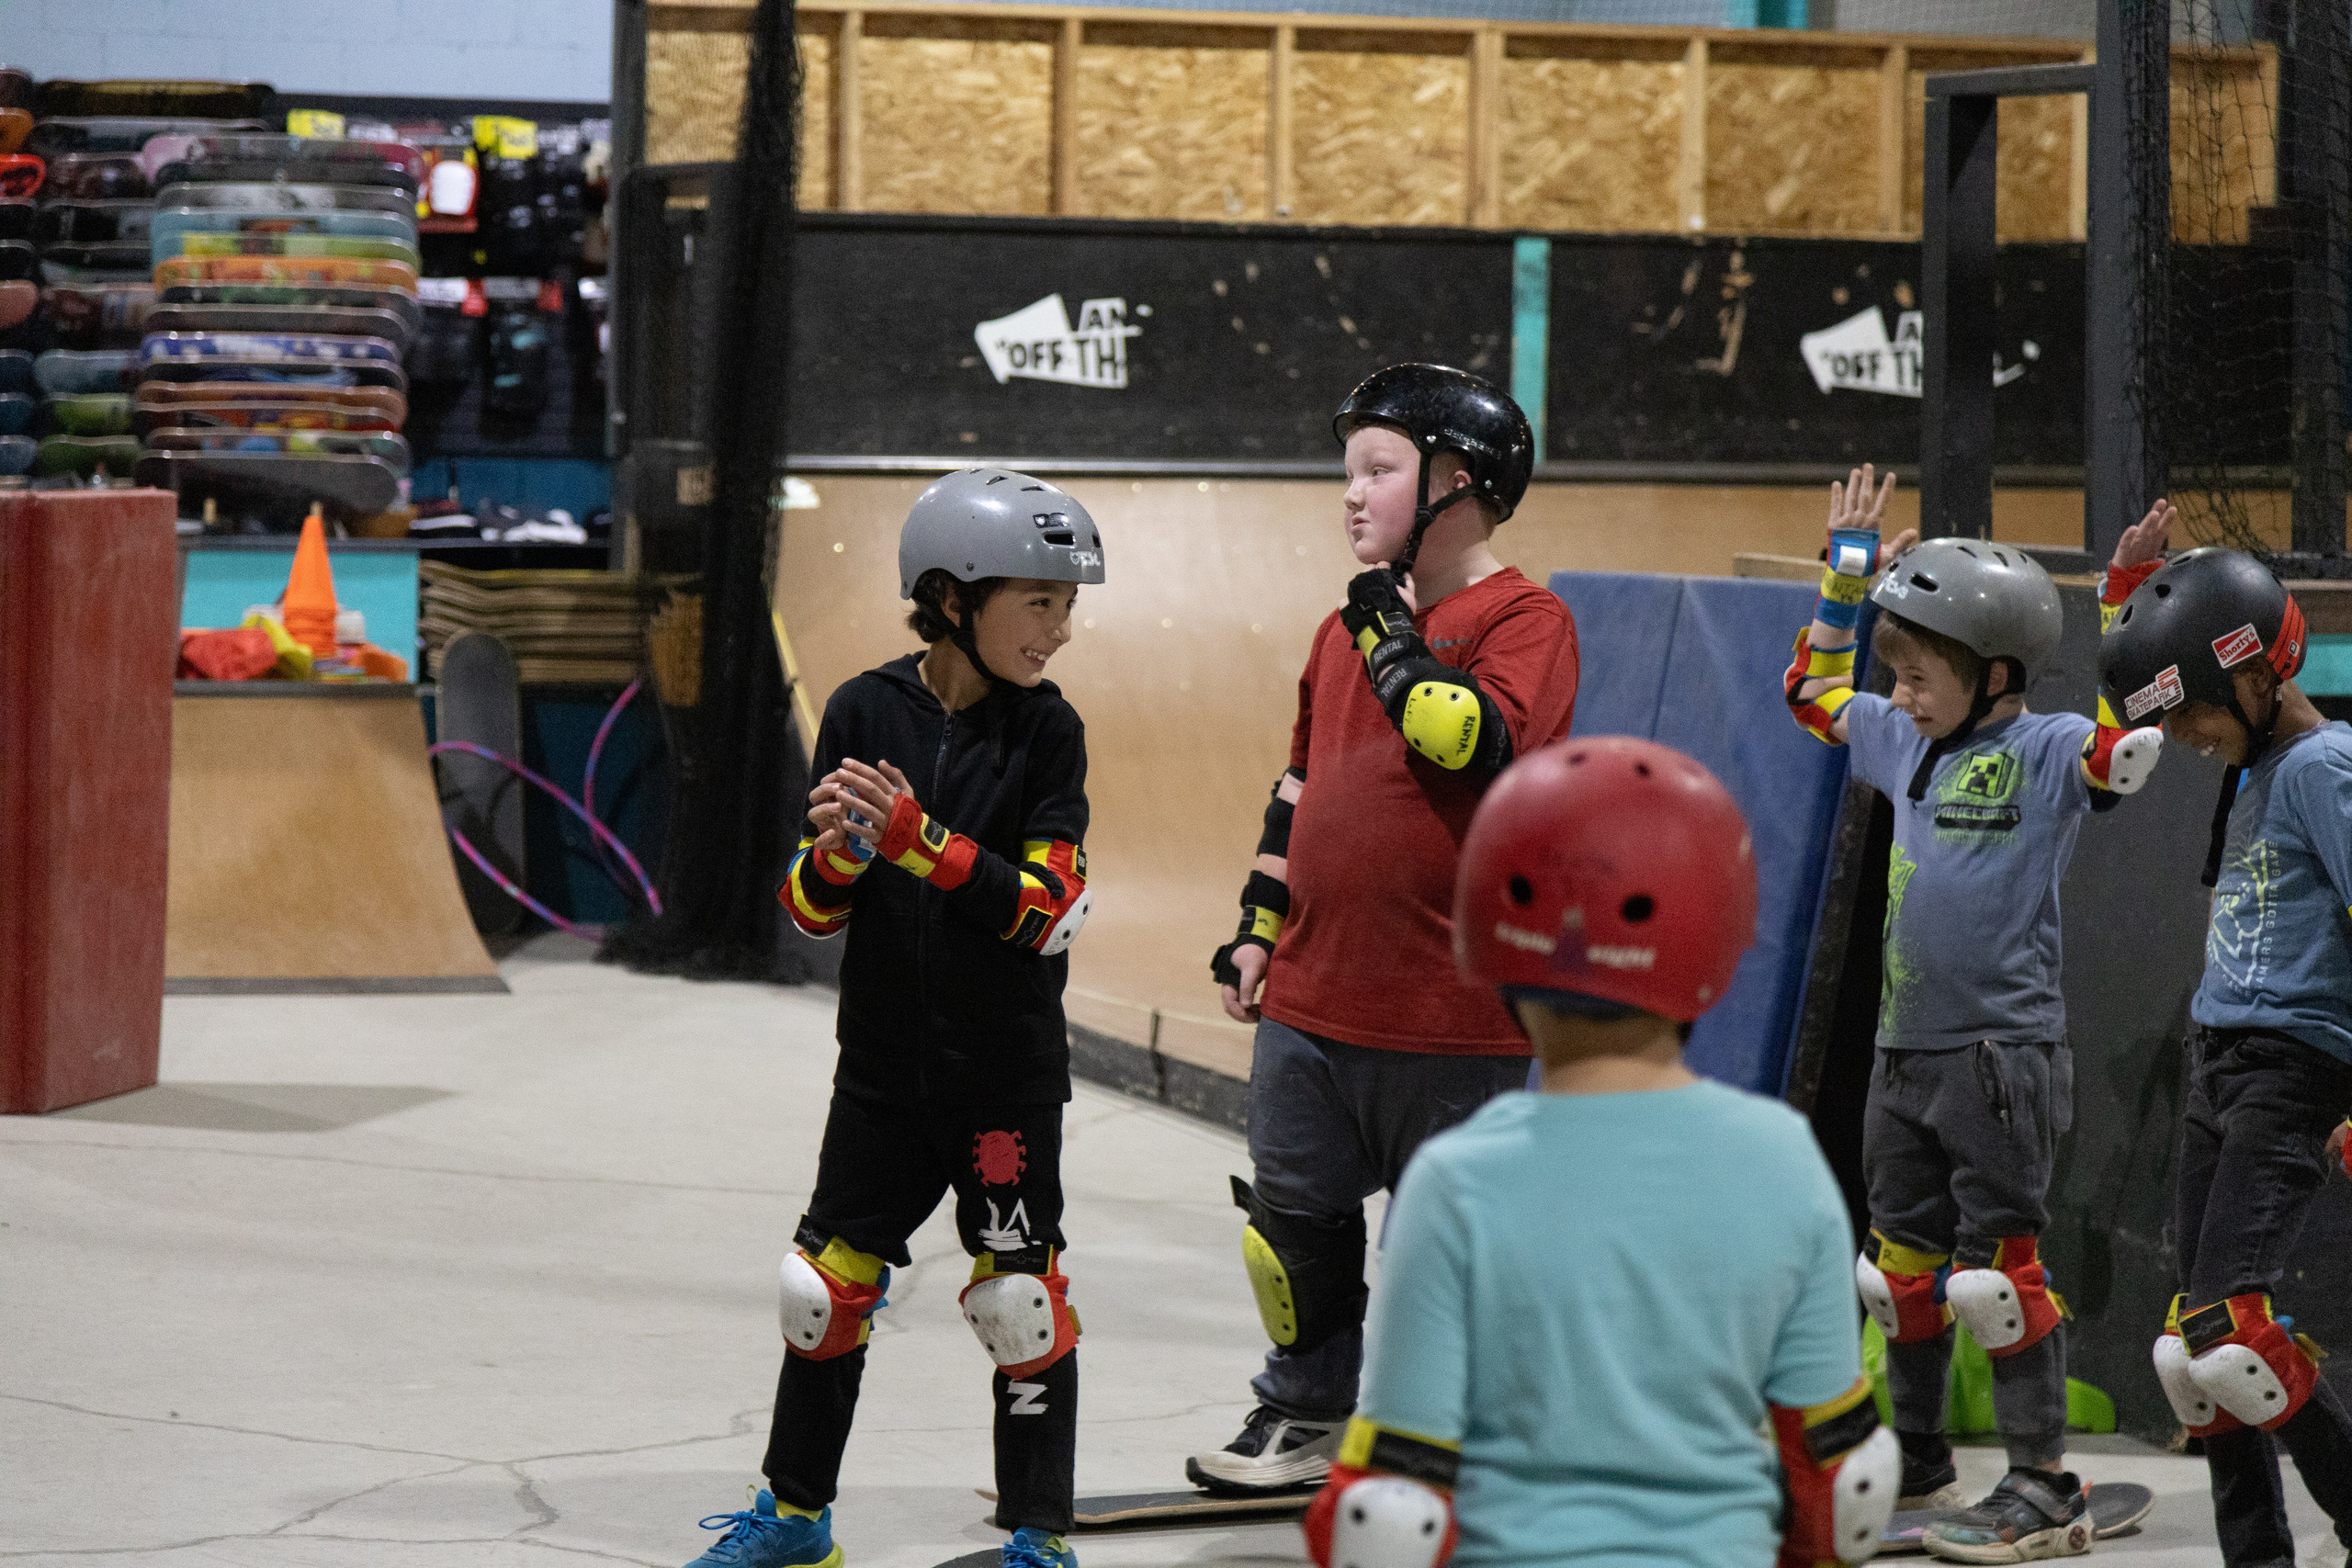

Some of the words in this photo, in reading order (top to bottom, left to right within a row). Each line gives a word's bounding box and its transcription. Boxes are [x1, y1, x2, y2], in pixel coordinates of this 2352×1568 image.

[1374, 639, 1404, 662] RENTAL
[2219, 628, 2256, 660] Shorty's
[1381, 667, 1408, 697] RENTAL
[2126, 683, 2160, 710] CINEMA
[2128, 689, 2171, 719] SKATEPARK
[1456, 716, 1476, 756] RENTAL
[2255, 936, 2274, 987] AMERS
[2267, 840, 2282, 877] GAME
